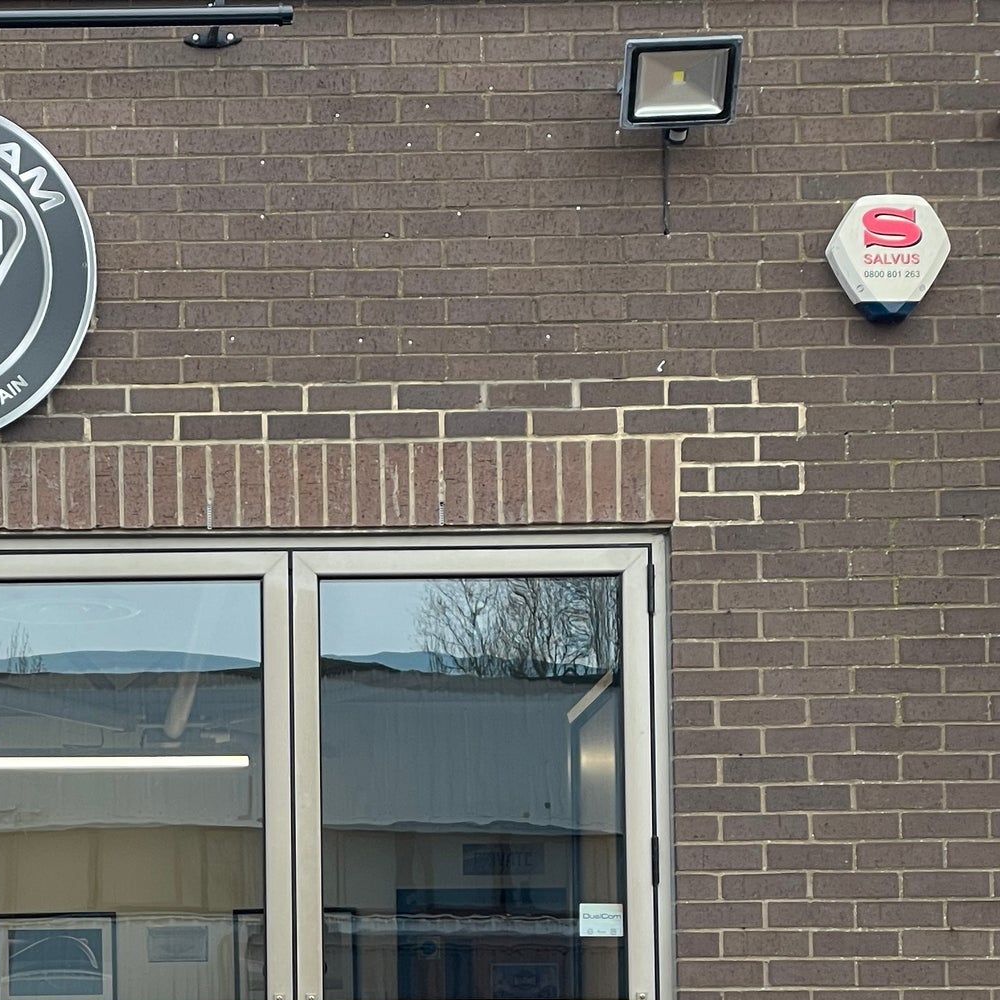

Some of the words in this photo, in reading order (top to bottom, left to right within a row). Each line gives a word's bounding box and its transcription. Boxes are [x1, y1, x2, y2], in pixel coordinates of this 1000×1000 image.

[863, 253, 920, 265] SALVUS
[864, 270, 885, 278] 0800
[887, 270, 902, 278] 801
[905, 270, 920, 278] 263
